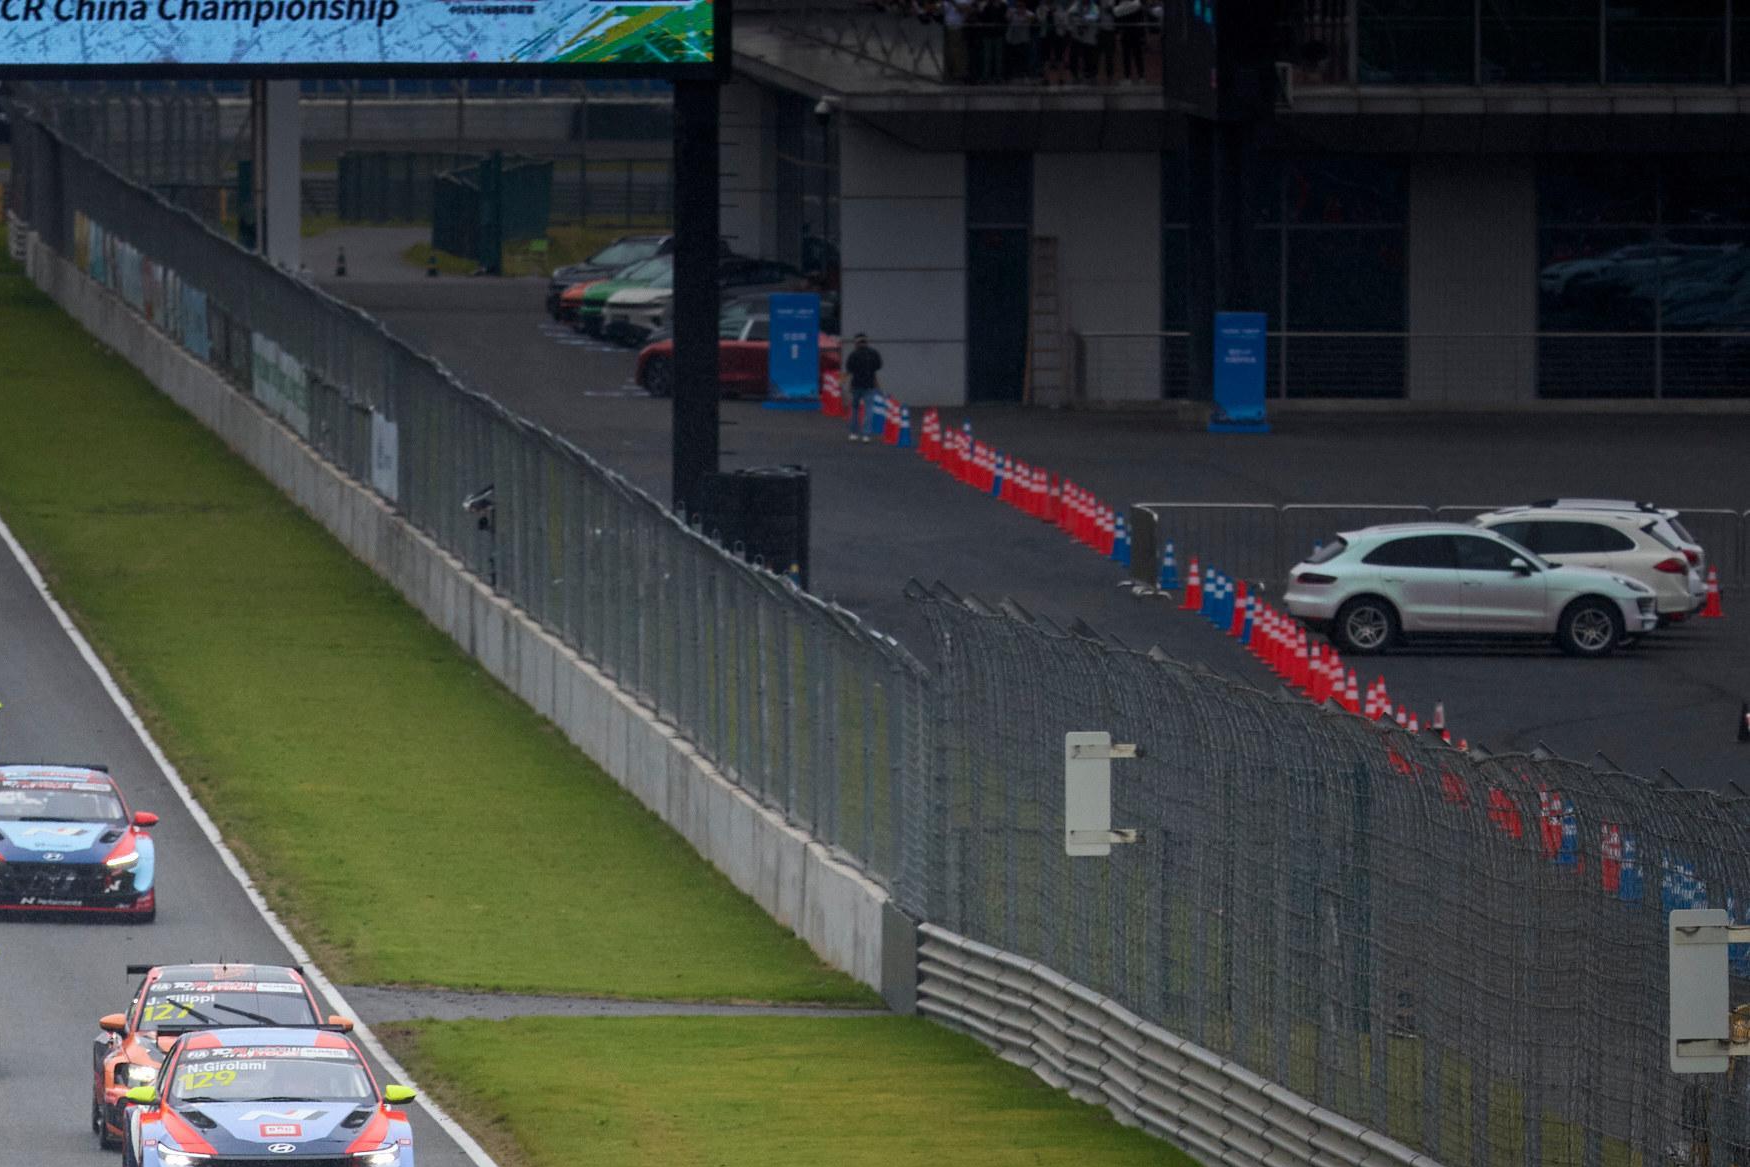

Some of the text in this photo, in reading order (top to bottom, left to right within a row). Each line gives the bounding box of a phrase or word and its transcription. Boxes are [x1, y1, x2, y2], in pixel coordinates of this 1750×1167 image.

[54, 0, 149, 23] China
[157, 0, 399, 27] Championship
[179, 1070, 237, 1091] 129
